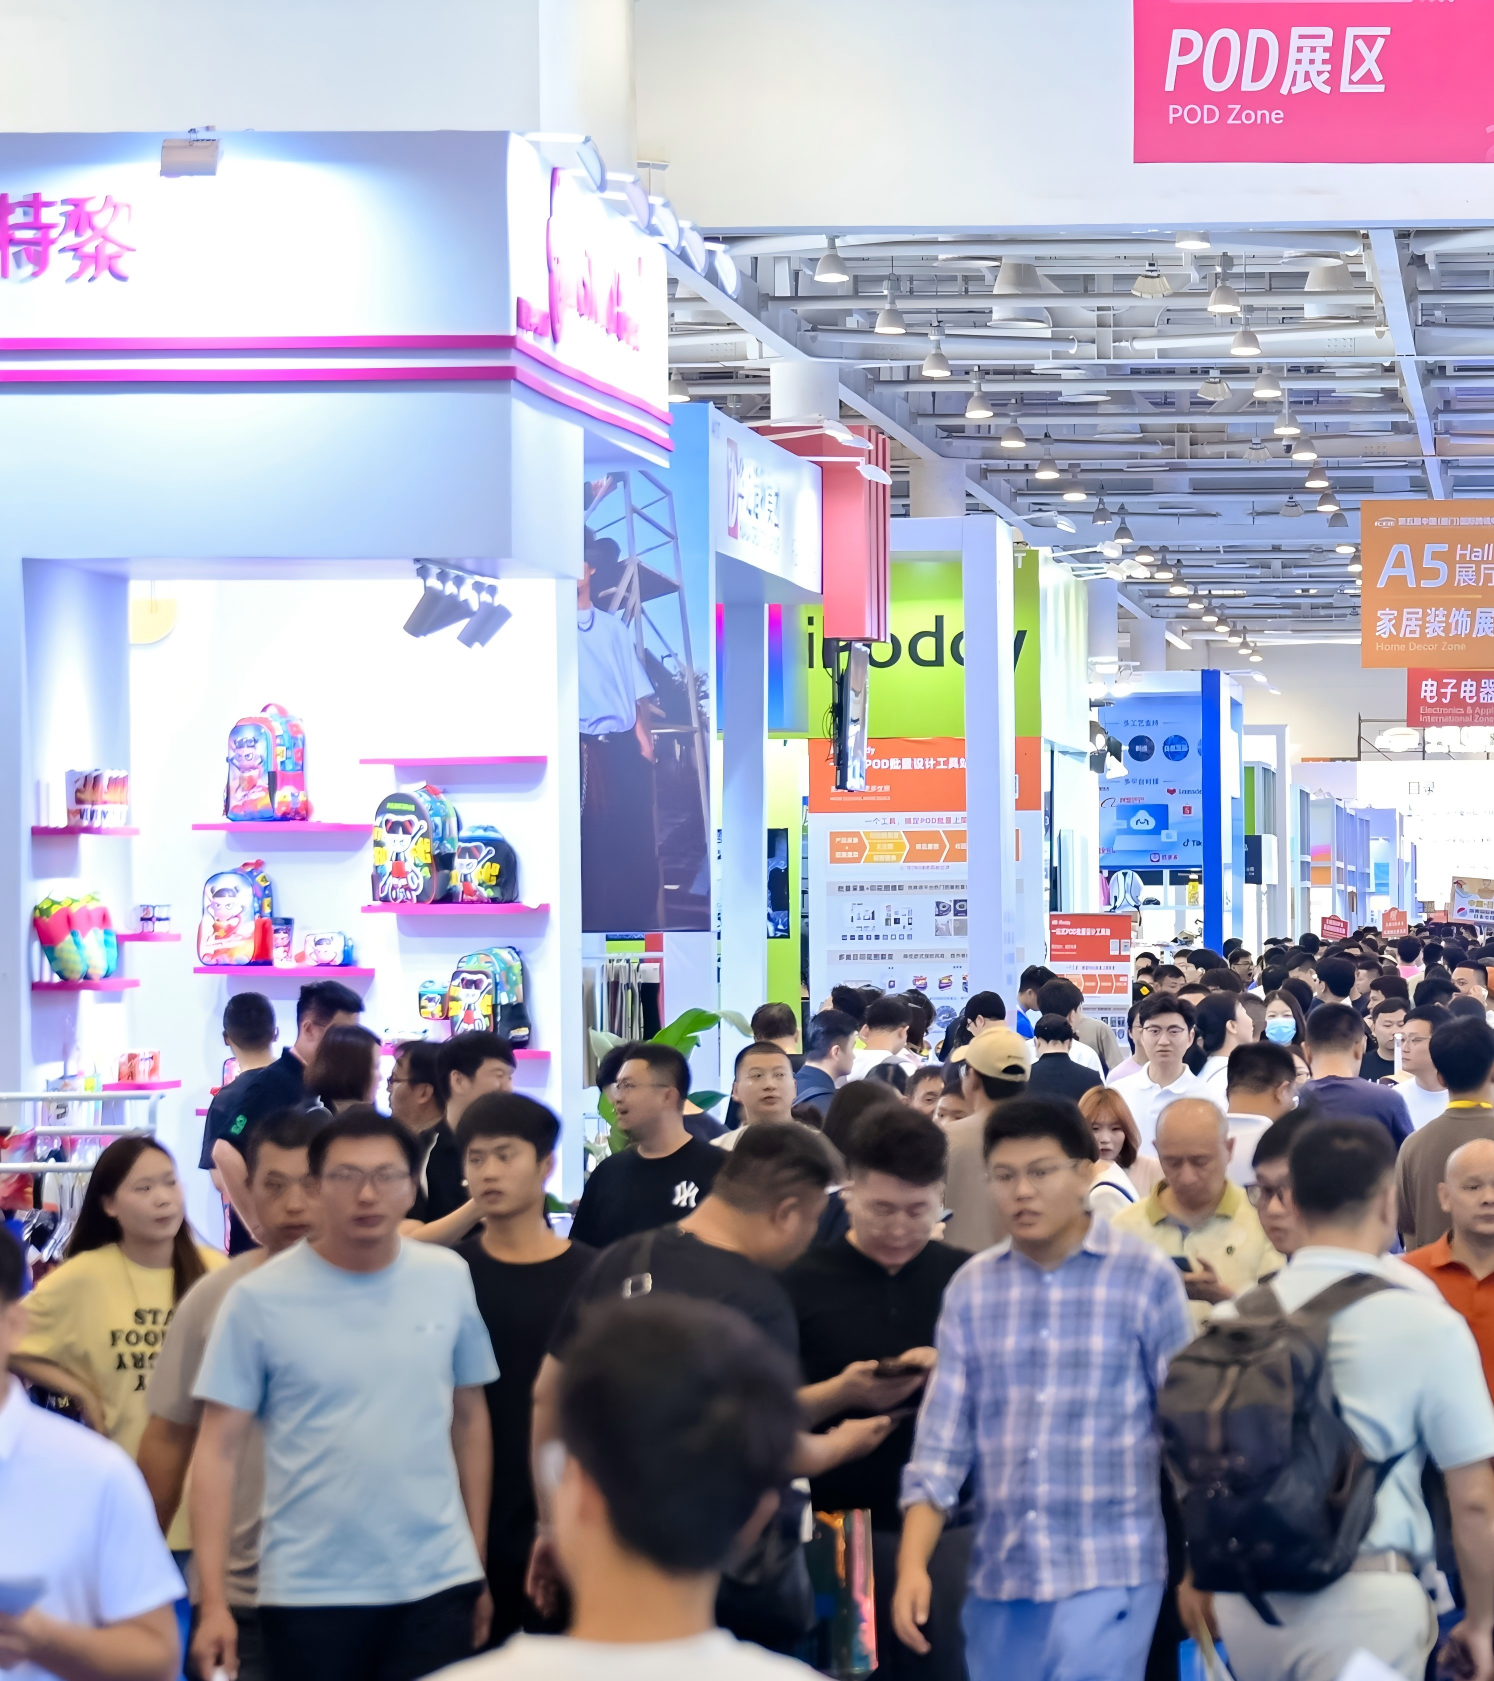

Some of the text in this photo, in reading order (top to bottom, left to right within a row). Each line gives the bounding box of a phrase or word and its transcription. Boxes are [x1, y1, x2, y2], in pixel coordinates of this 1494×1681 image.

[1164, 26, 1392, 96] POD展区
[1168, 104, 1285, 125] POD Zone
[1376, 543, 1494, 588] A5 Hall
[1376, 641, 1406, 651] Home
[1408, 641, 1438, 651] Decor
[1466, 705, 1473, 715] &
[1474, 714, 1494, 724] Zone
